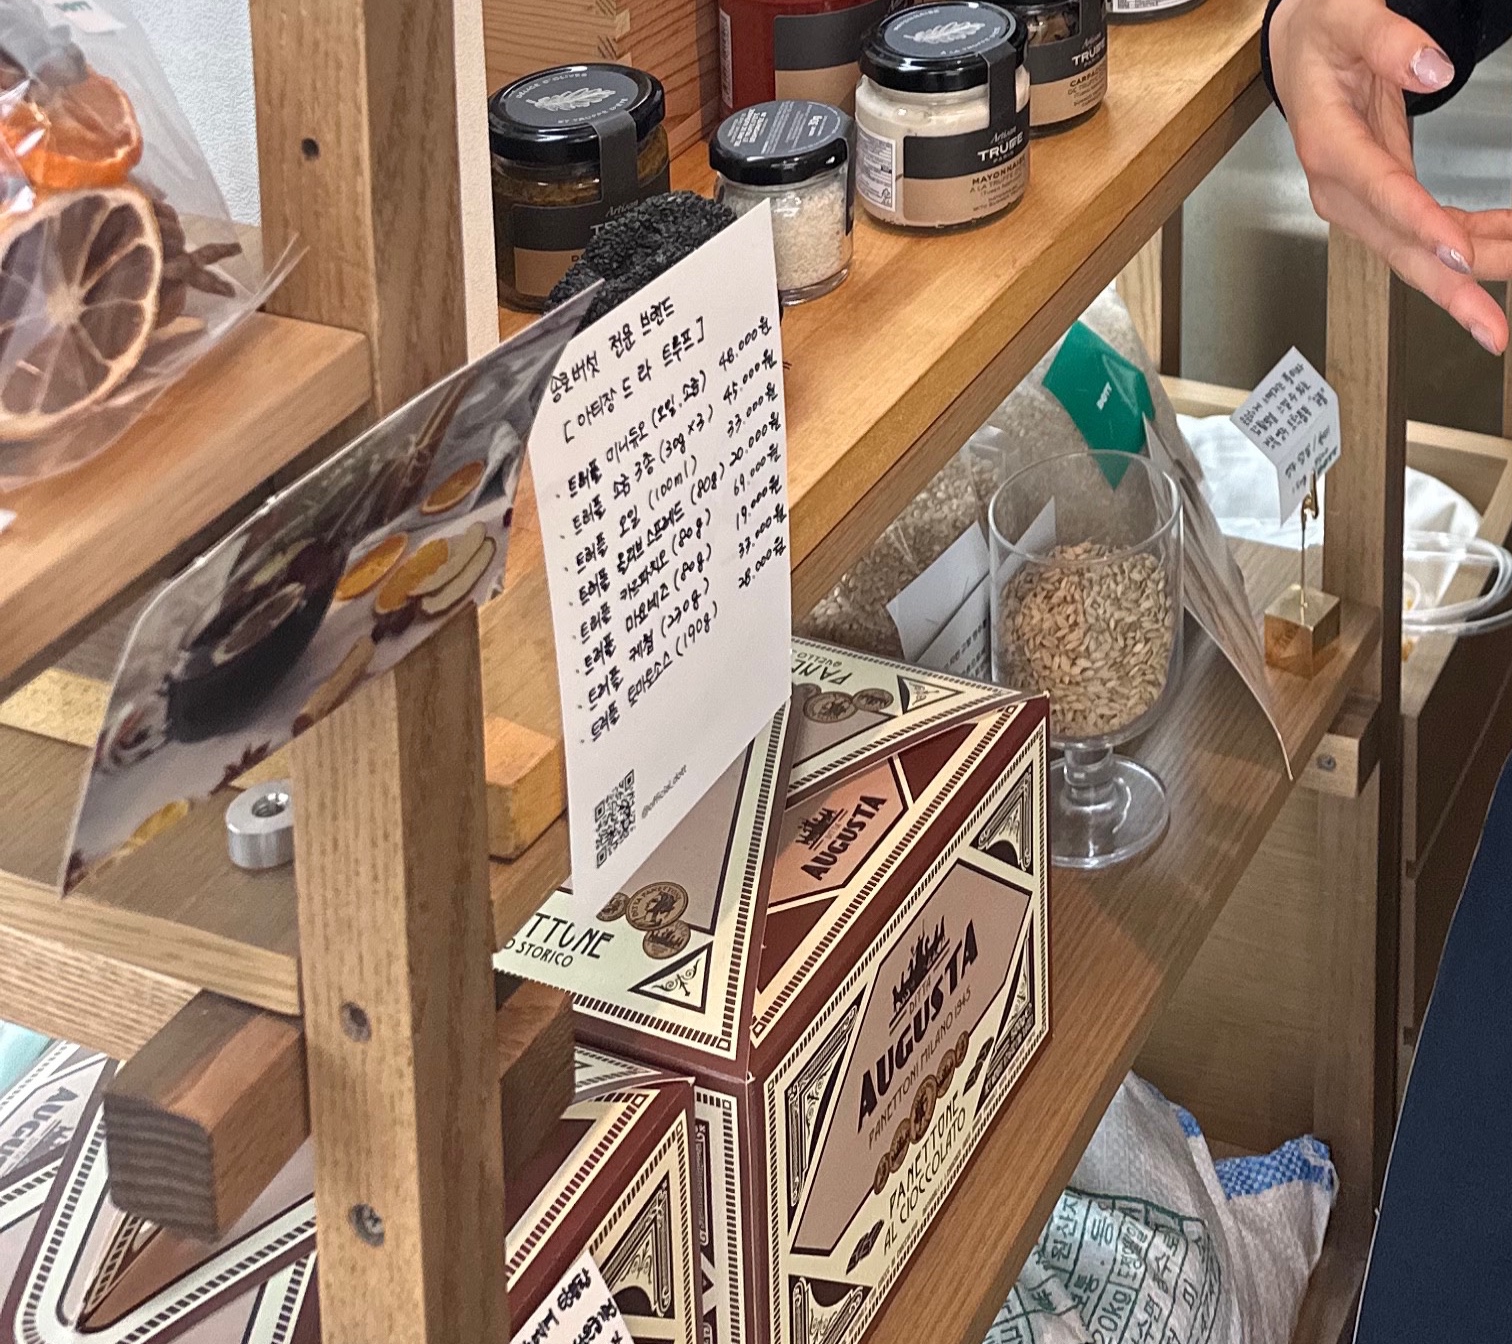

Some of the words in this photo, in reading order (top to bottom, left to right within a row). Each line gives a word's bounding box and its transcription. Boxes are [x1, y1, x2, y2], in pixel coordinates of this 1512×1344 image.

[976, 132, 1025, 162] TRUFFE
[550, 350, 601, 404] 송로버섯
[608, 322, 637, 359] 전문
[622, 376, 634, 400] 드
[637, 358, 653, 383] 라
[567, 458, 603, 499] 트러플
[605, 420, 649, 463] 미니듀오
[572, 493, 607, 536] 트러플
[612, 473, 632, 500] 소금
[634, 451, 656, 483] 3종
[575, 531, 610, 575] 트러플
[618, 504, 642, 540] 오일
[648, 454, 698, 512] (100ml)
[726, 381, 779, 439] 33.000원
[578, 566, 612, 607] 트러플
[616, 536, 645, 577] 올리브
[646, 499, 686, 548] 스프레드
[690, 461, 726, 506] (80g)
[579, 601, 613, 645] 트러플
[671, 507, 712, 557] (80g)
[733, 442, 782, 498] 69.000원
[583, 631, 618, 677] 트러플
[624, 582, 671, 634] 마요네즈
[673, 542, 712, 592] (80g)
[735, 474, 783, 532] 19.000원
[587, 664, 625, 712] 트러플
[628, 628, 655, 663] 케첩
[660, 576, 710, 639] (230g)
[738, 502, 788, 560] 33.000원
[590, 699, 622, 743] 트러플
[626, 650, 674, 708] 토마토소스
[675, 599, 719, 658] (190g)
[738, 535, 787, 589] 28.000원
[801, 794, 889, 882] AUGUSTA
[515, 940, 575, 969] STORICO
[526, 912, 615, 960] TTONE
[907, 976, 934, 1018] DITTA
[857, 917, 980, 1135] AUGUSTA
[867, 1062, 921, 1151] PANETTONI
[918, 1018, 955, 1074] MILANO
[951, 985, 974, 1025] 1945
[883, 1221, 901, 1258] AL
[898, 1106, 969, 1226] CIOCCOLATO
[888, 1090, 961, 1214] PANETTONE
